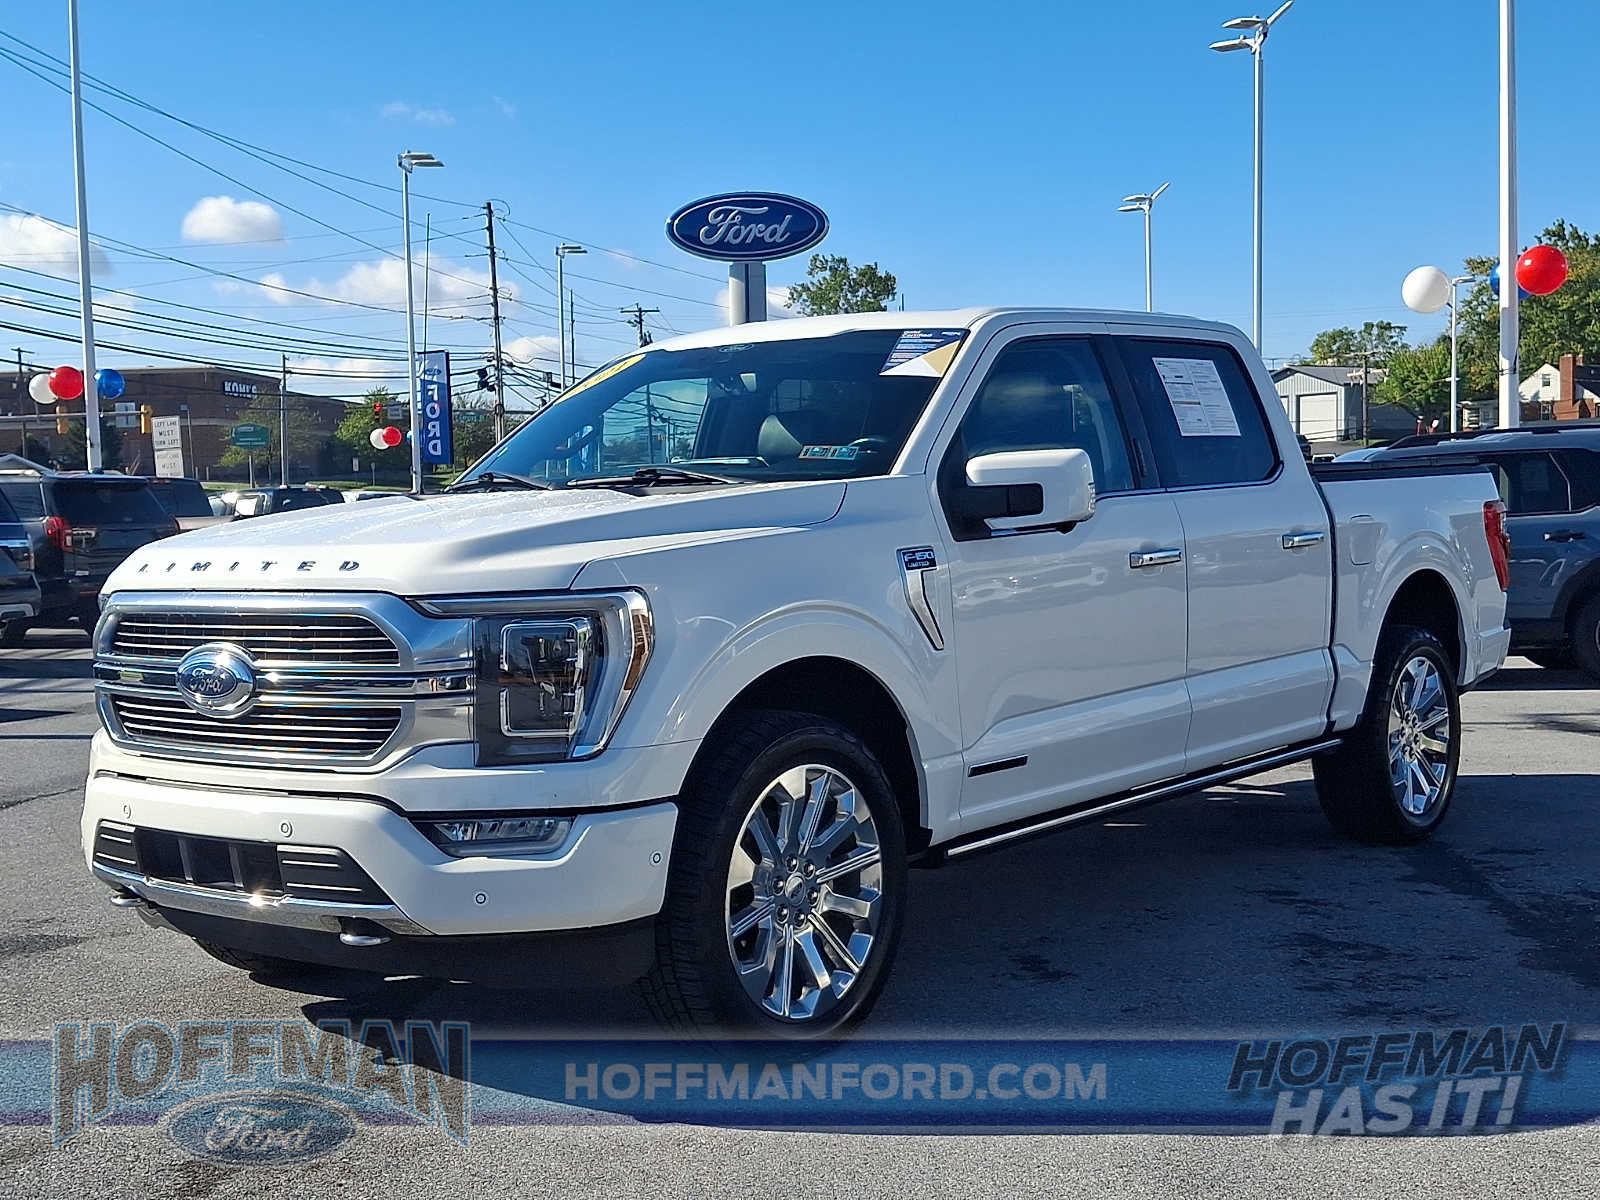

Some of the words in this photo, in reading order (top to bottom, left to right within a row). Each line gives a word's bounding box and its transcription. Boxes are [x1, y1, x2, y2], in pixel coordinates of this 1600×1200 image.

[700, 205, 792, 245] Ford
[904, 551, 934, 561] F-150
[138, 560, 360, 573] LIMITED
[189, 667, 224, 693] Ford
